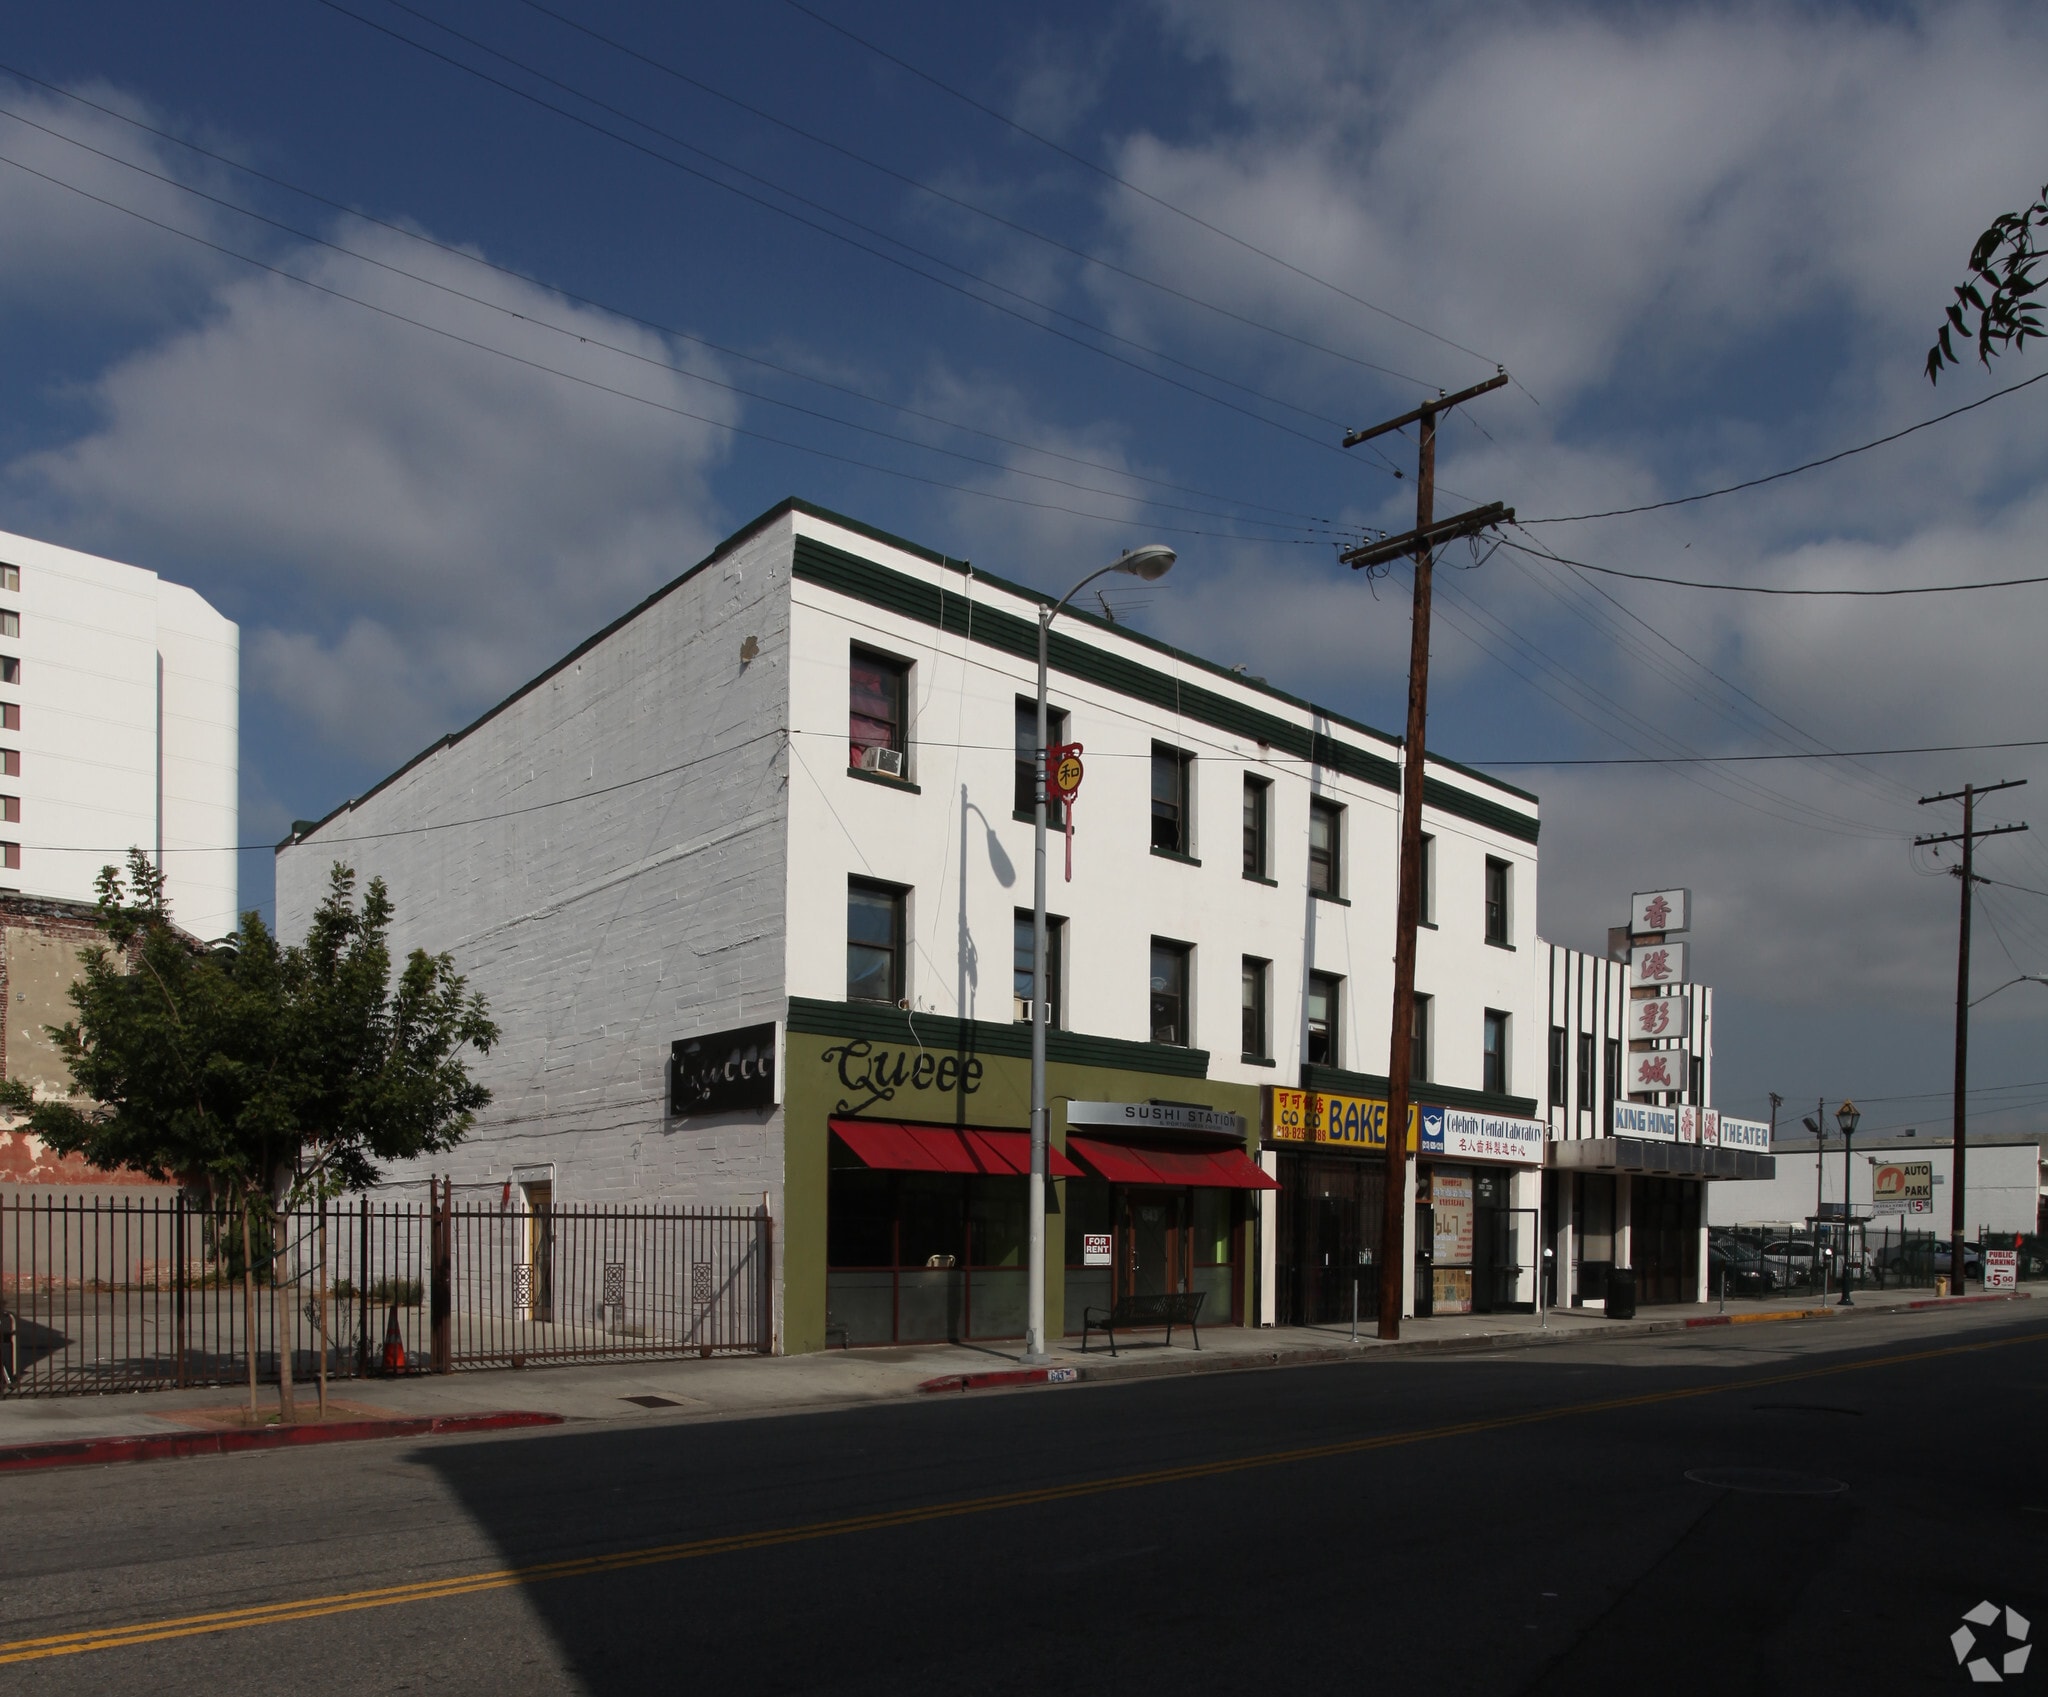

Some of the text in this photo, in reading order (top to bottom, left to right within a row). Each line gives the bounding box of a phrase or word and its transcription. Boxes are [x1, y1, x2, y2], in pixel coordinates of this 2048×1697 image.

[1060, 764, 1079, 785] 和
[821, 1039, 983, 1116] Queee
[1125, 1106, 1235, 1127] SUSHI STATION
[1329, 1100, 1413, 1144] BAKEY
[1447, 1114, 1541, 1142] Celebrity Dental Laboratory
[1615, 1107, 1645, 1132] KING
[1647, 1112, 1674, 1134] HING
[1723, 1123, 1768, 1147] THEATER
[1904, 1165, 1929, 1176] AUTO
[1905, 1186, 1929, 1196] PARK
